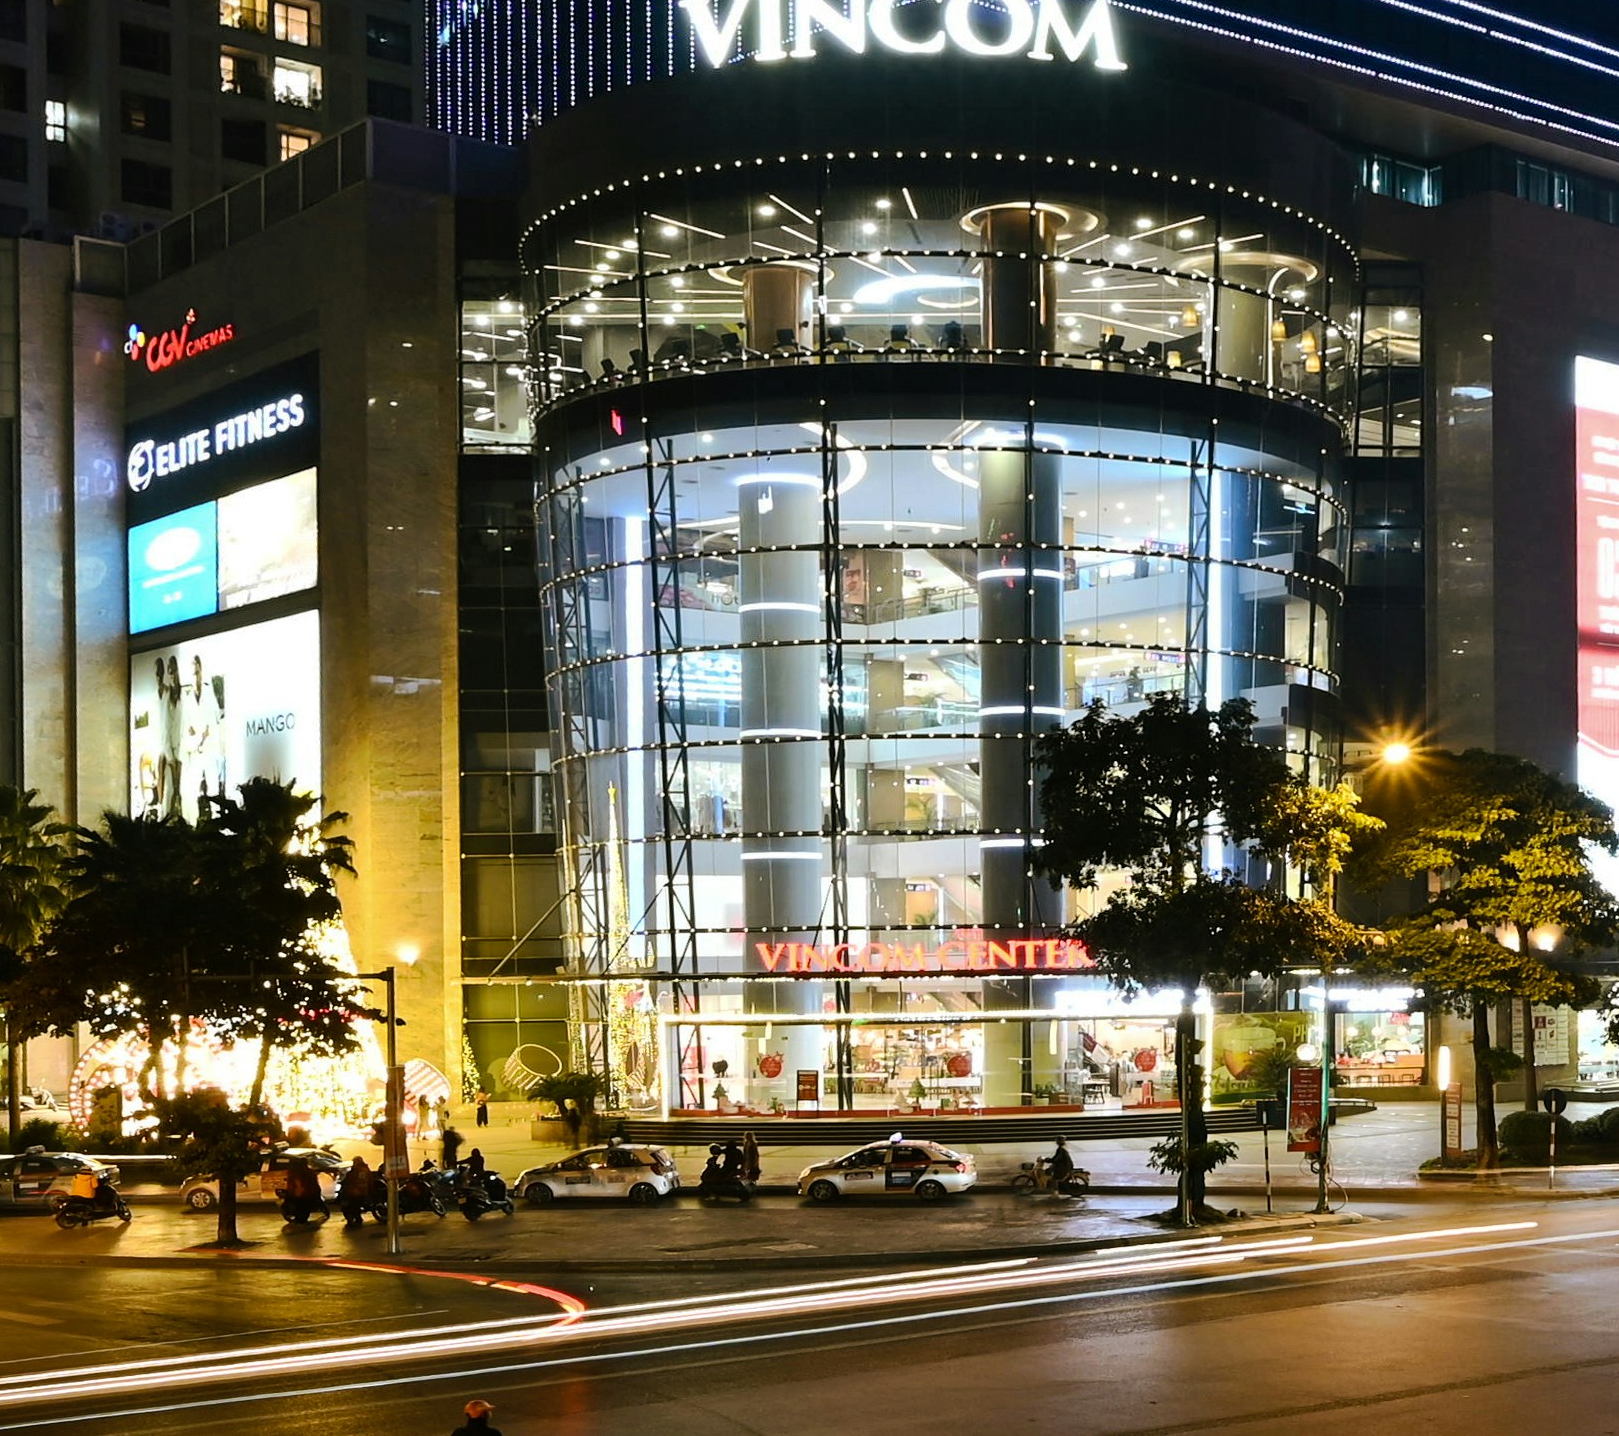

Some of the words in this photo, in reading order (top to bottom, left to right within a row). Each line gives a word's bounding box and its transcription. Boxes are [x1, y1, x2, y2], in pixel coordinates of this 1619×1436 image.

[146, 323, 190, 373] CGV
[186, 323, 235, 357] CINEMAS
[156, 427, 211, 478] ELITE
[215, 392, 306, 456] FITNESS
[245, 712, 296, 738] MANGO
[755, 942, 927, 973] VINCOM
[937, 939, 1098, 971] CENTER
